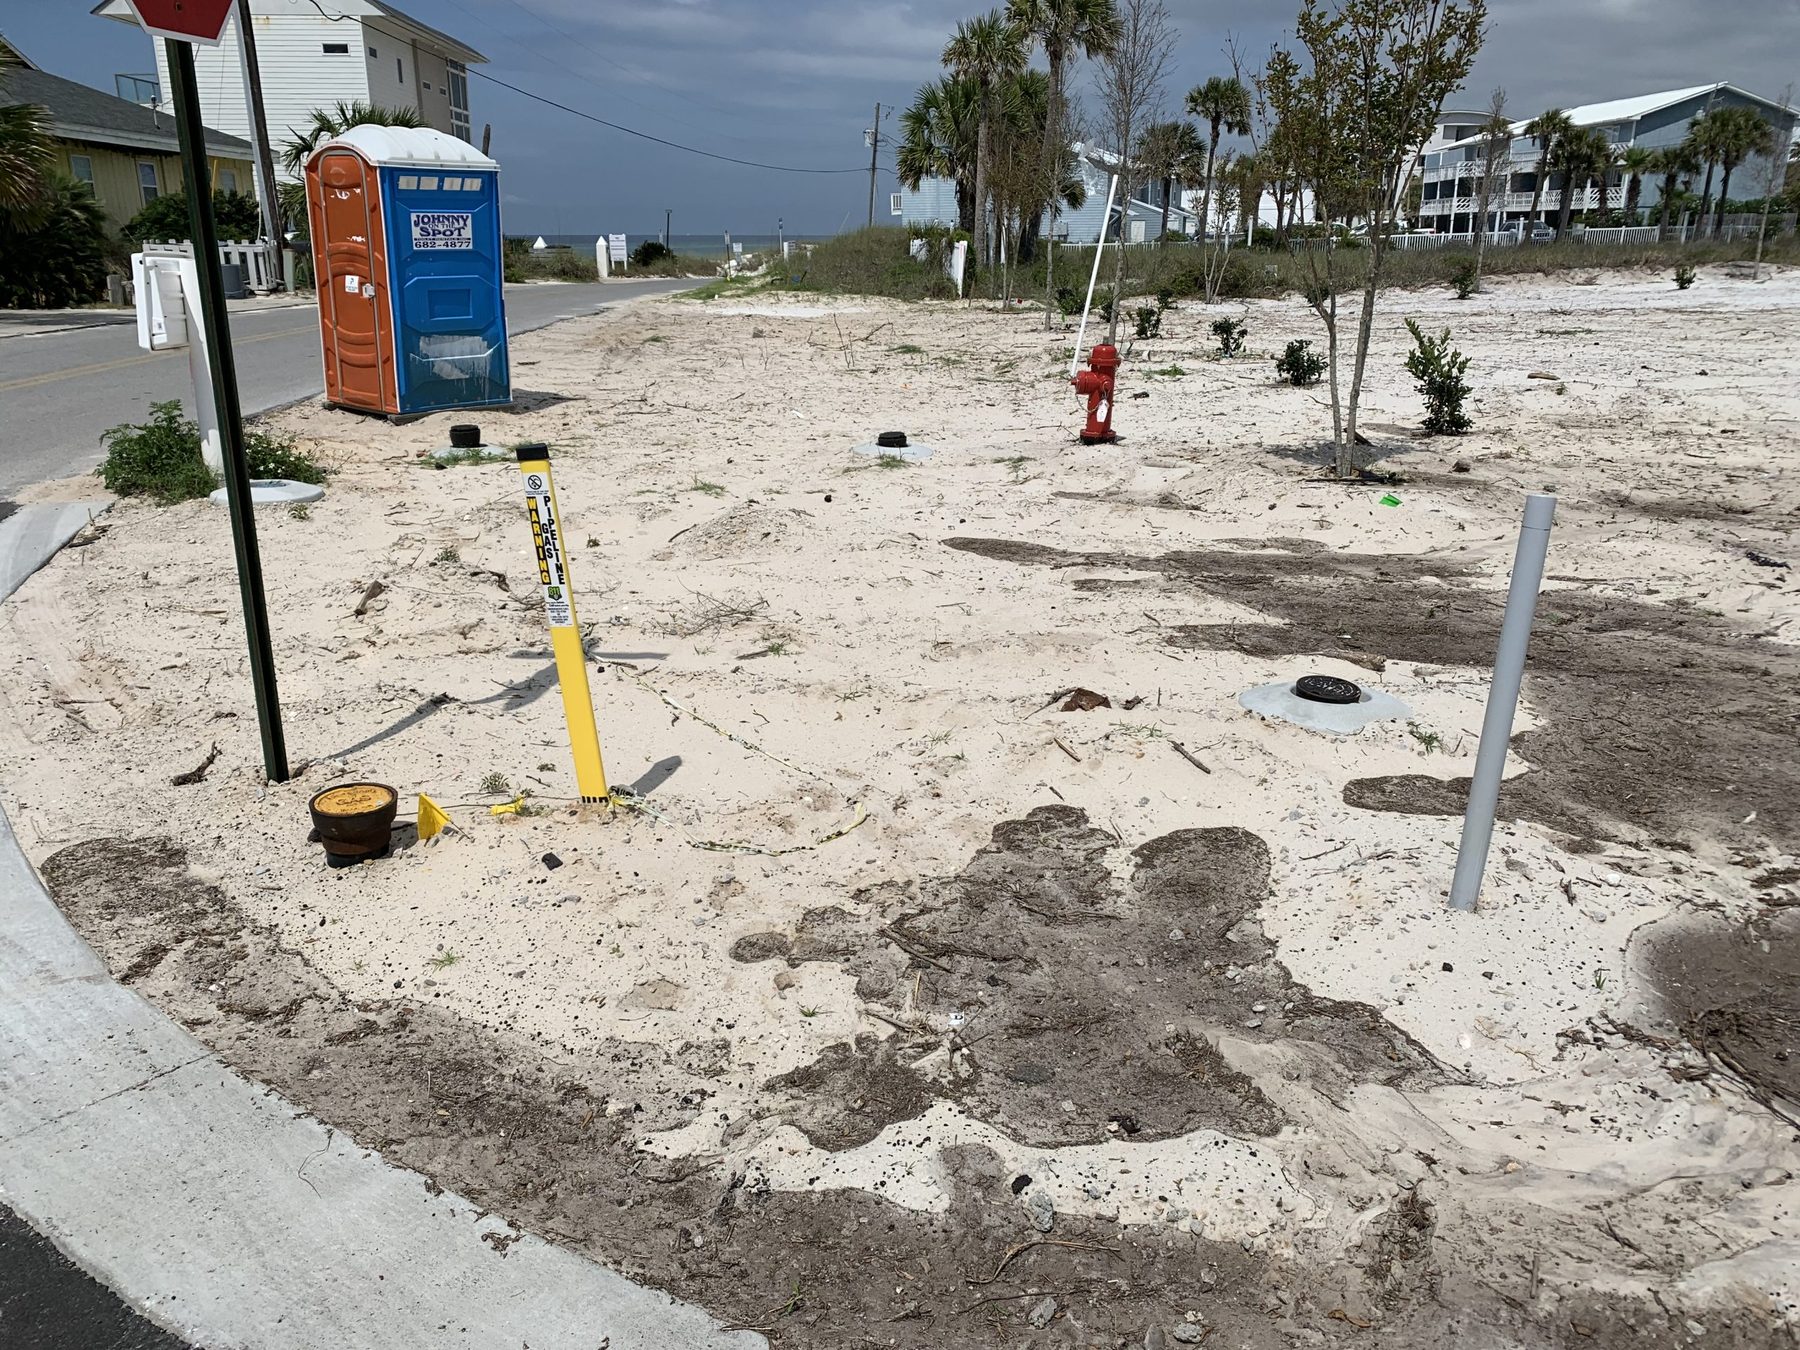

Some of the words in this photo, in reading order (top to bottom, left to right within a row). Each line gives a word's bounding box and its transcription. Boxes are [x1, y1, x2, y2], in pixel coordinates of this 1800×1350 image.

[413, 214, 470, 228] JOHNNY
[419, 226, 466, 237] SPOT
[414, 241, 471, 249] 682-4877
[526, 497, 550, 583] WARNING
[541, 523, 554, 559] GAS
[543, 495, 565, 585] PIPELINE
